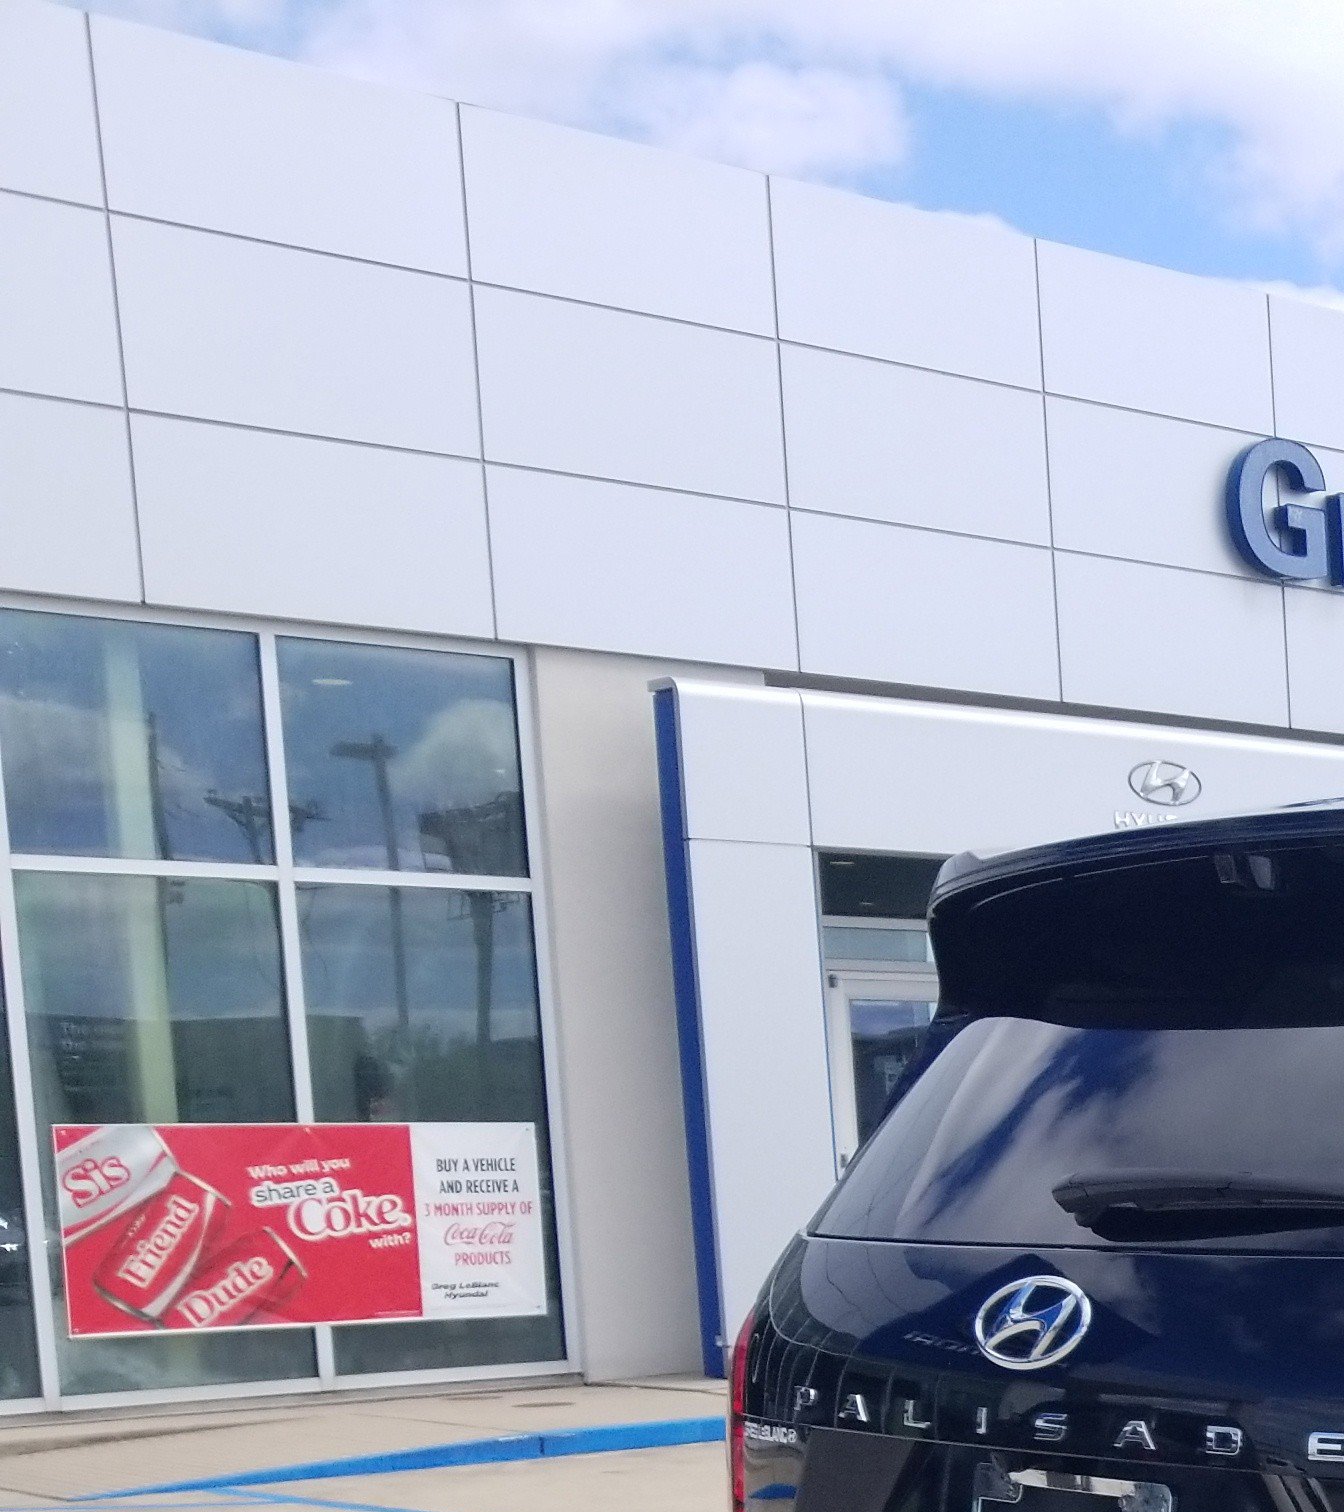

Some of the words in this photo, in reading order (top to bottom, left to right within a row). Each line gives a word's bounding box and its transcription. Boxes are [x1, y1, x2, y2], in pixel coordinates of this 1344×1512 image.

[248, 1164, 288, 1178] Who
[291, 1159, 318, 1174] will
[321, 1158, 350, 1172] you
[436, 1158, 458, 1172] BUY
[462, 1158, 470, 1171] A
[473, 1158, 516, 1171] VEHICLE
[63, 1157, 130, 1208] Sis
[440, 1180, 462, 1194] AND
[466, 1179, 508, 1193] RECEIVE
[512, 1178, 519, 1192] A
[256, 1183, 317, 1203] share
[323, 1181, 335, 1194] a
[425, 1203, 430, 1216] 3
[434, 1203, 473, 1216] MONTH
[476, 1202, 516, 1215] SUPPLY
[520, 1201, 532, 1214] OF
[117, 1195, 199, 1289] Friend
[370, 1232, 411, 1248] with?
[455, 1251, 511, 1266] PRODUCTS
[177, 1256, 274, 1328] Dude
